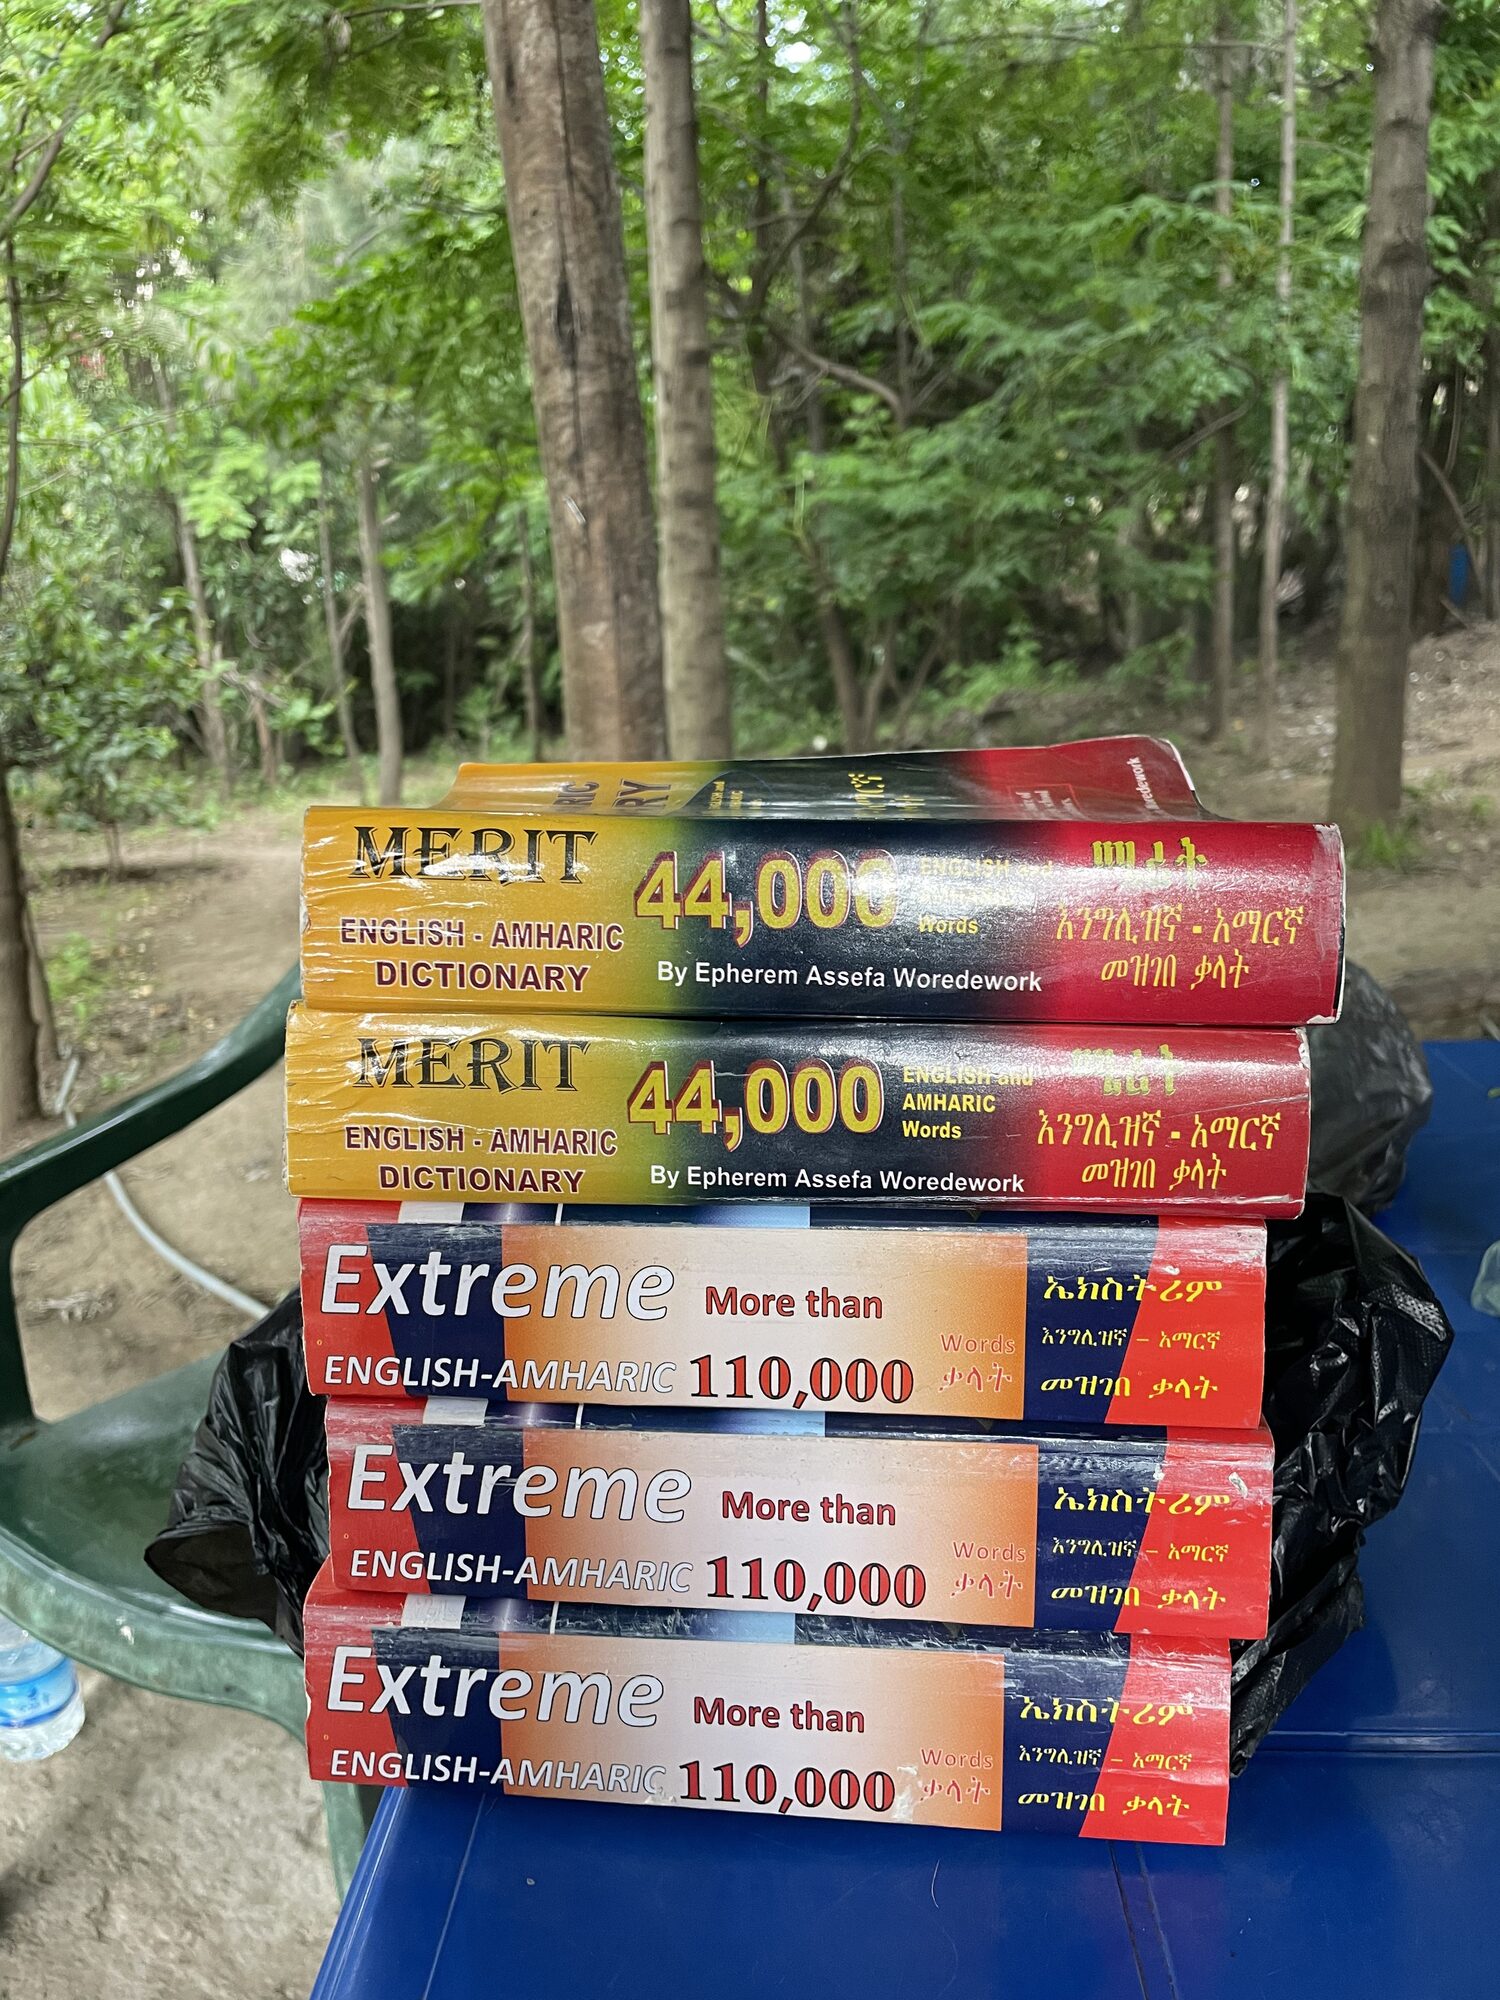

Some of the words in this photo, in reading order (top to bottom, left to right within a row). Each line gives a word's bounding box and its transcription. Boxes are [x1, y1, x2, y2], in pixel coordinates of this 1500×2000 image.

[348, 826, 597, 886] MERIT
[919, 857, 1010, 878] ENGLISH
[633, 849, 899, 948] 44,000
[340, 917, 466, 948] ENGLISH
[491, 921, 625, 952] AMHARIC
[918, 914, 979, 934] Words
[1056, 902, 1182, 944] እንግሊዝኛ
[1212, 905, 1304, 947] አማርኛ
[375, 960, 591, 992] DICTIONARY
[657, 961, 685, 987] By
[695, 961, 798, 989] Epherem
[805, 966, 886, 988] Assefa
[894, 967, 1043, 992] Woredework
[1101, 953, 1177, 989] መዝገበ
[1190, 949, 1250, 989] ቃላት
[353, 1038, 591, 1094] MERIT
[903, 1066, 991, 1085] ENGLISH
[997, 1068, 1033, 1086] and
[627, 1057, 885, 1152] 44,000
[903, 1093, 996, 1113] AMHARIC
[345, 1125, 465, 1152] ENGLISH
[489, 1128, 618, 1156] AMHARIC
[902, 1120, 962, 1139] Words
[1037, 1109, 1162, 1149] እንግሊዝኛ
[1190, 1112, 1281, 1150] አማርኛ
[378, 1164, 585, 1194] DICTIONARY
[650, 1165, 680, 1188] By
[687, 1166, 787, 1189] Epherem
[795, 1168, 872, 1190] Assefa
[880, 1170, 1025, 1193] Woredework
[1081, 1157, 1156, 1189] መዝገበ
[1168, 1152, 1227, 1190] ቃላት
[321, 1243, 675, 1321] Extreme
[1043, 1274, 1223, 1303] ኤክስትሪም
[705, 1286, 795, 1317] More
[805, 1287, 883, 1319] than
[940, 1333, 1015, 1354] Words
[1042, 1327, 1128, 1347] እንግሊዝኛ
[1159, 1331, 1221, 1350] አማርኛ
[324, 1355, 677, 1393] ENGLISH-AMHARIC
[690, 1354, 914, 1409] 110,000
[938, 1362, 1013, 1393] ቃላት
[1040, 1375, 1131, 1397] መዝገበ
[1148, 1376, 1218, 1400] ቃላት
[347, 1443, 692, 1523] Extreme
[722, 1490, 810, 1522] More
[820, 1493, 897, 1526] than
[1054, 1486, 1231, 1516] ኤክስትሪም
[952, 1540, 1026, 1562] Words
[1052, 1537, 1137, 1557] እንግሊዝኛ
[1168, 1543, 1229, 1563] አማርኛ
[350, 1549, 694, 1593] ENGLISH-AMHARIC
[706, 1555, 926, 1612] 110,000
[950, 1570, 1023, 1599] ቃላት
[1051, 1584, 1140, 1607] መዝገበ
[1158, 1586, 1226, 1611] ቃላት
[327, 1645, 664, 1728] Extreme
[693, 1696, 780, 1728] More
[790, 1700, 865, 1734] than
[1020, 1696, 1193, 1726] ኤክስትሪም
[330, 1749, 666, 1795] ENGLISH-AMHARIC
[920, 1748, 994, 1769] Words
[1019, 1745, 1102, 1766] እንግሊዝኛ
[1132, 1752, 1193, 1771] አማርኛ
[679, 1760, 896, 1815] 110,000
[918, 1776, 990, 1805] ቃላት
[1018, 1791, 1105, 1812] መዝገበ
[1123, 1794, 1190, 1817] ቃላት
